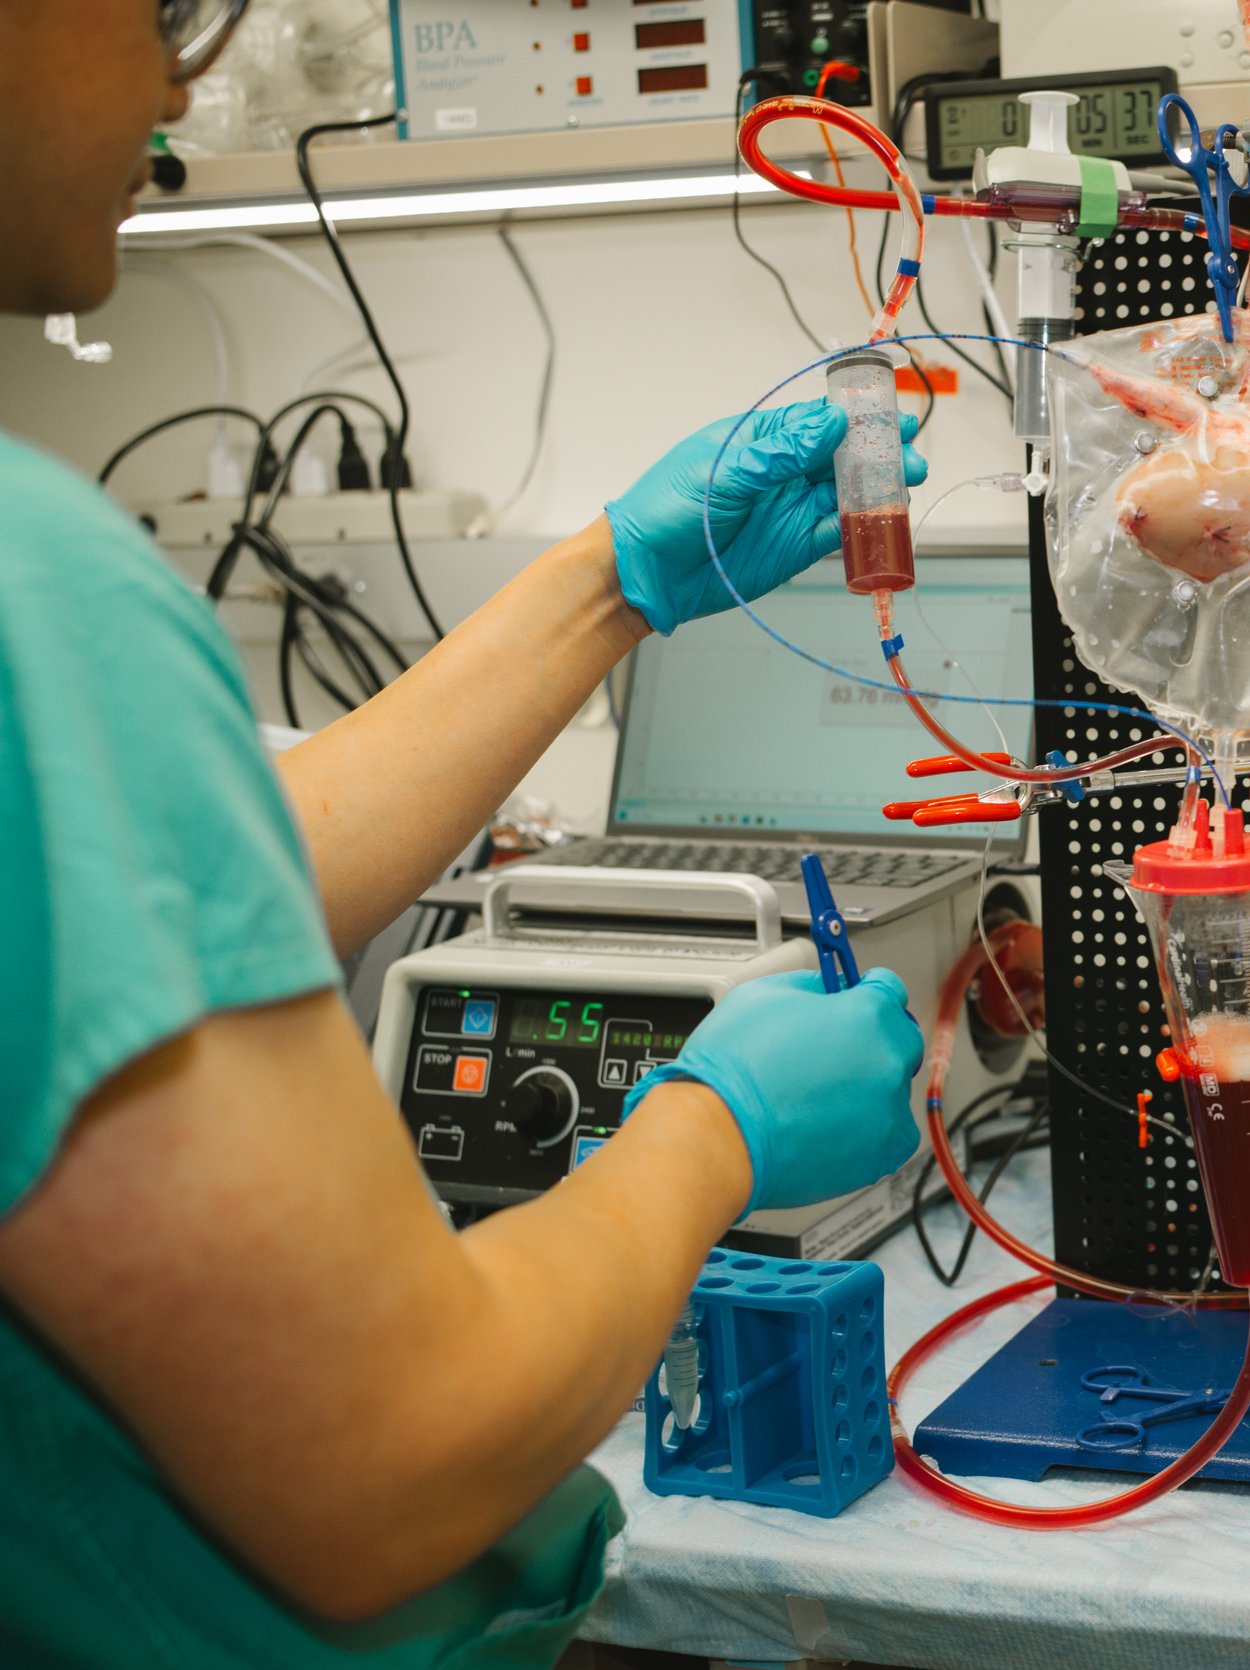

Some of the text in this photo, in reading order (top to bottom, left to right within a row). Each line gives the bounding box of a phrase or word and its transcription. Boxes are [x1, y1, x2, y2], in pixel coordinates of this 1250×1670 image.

[414, 18, 477, 53] BPA
[1074, 94, 1107, 134] 05
[1124, 90, 1153, 132] 37
[1125, 135, 1149, 145] SEC
[663, 1034, 684, 1048] RP
[423, 1053, 452, 1065] STOP
